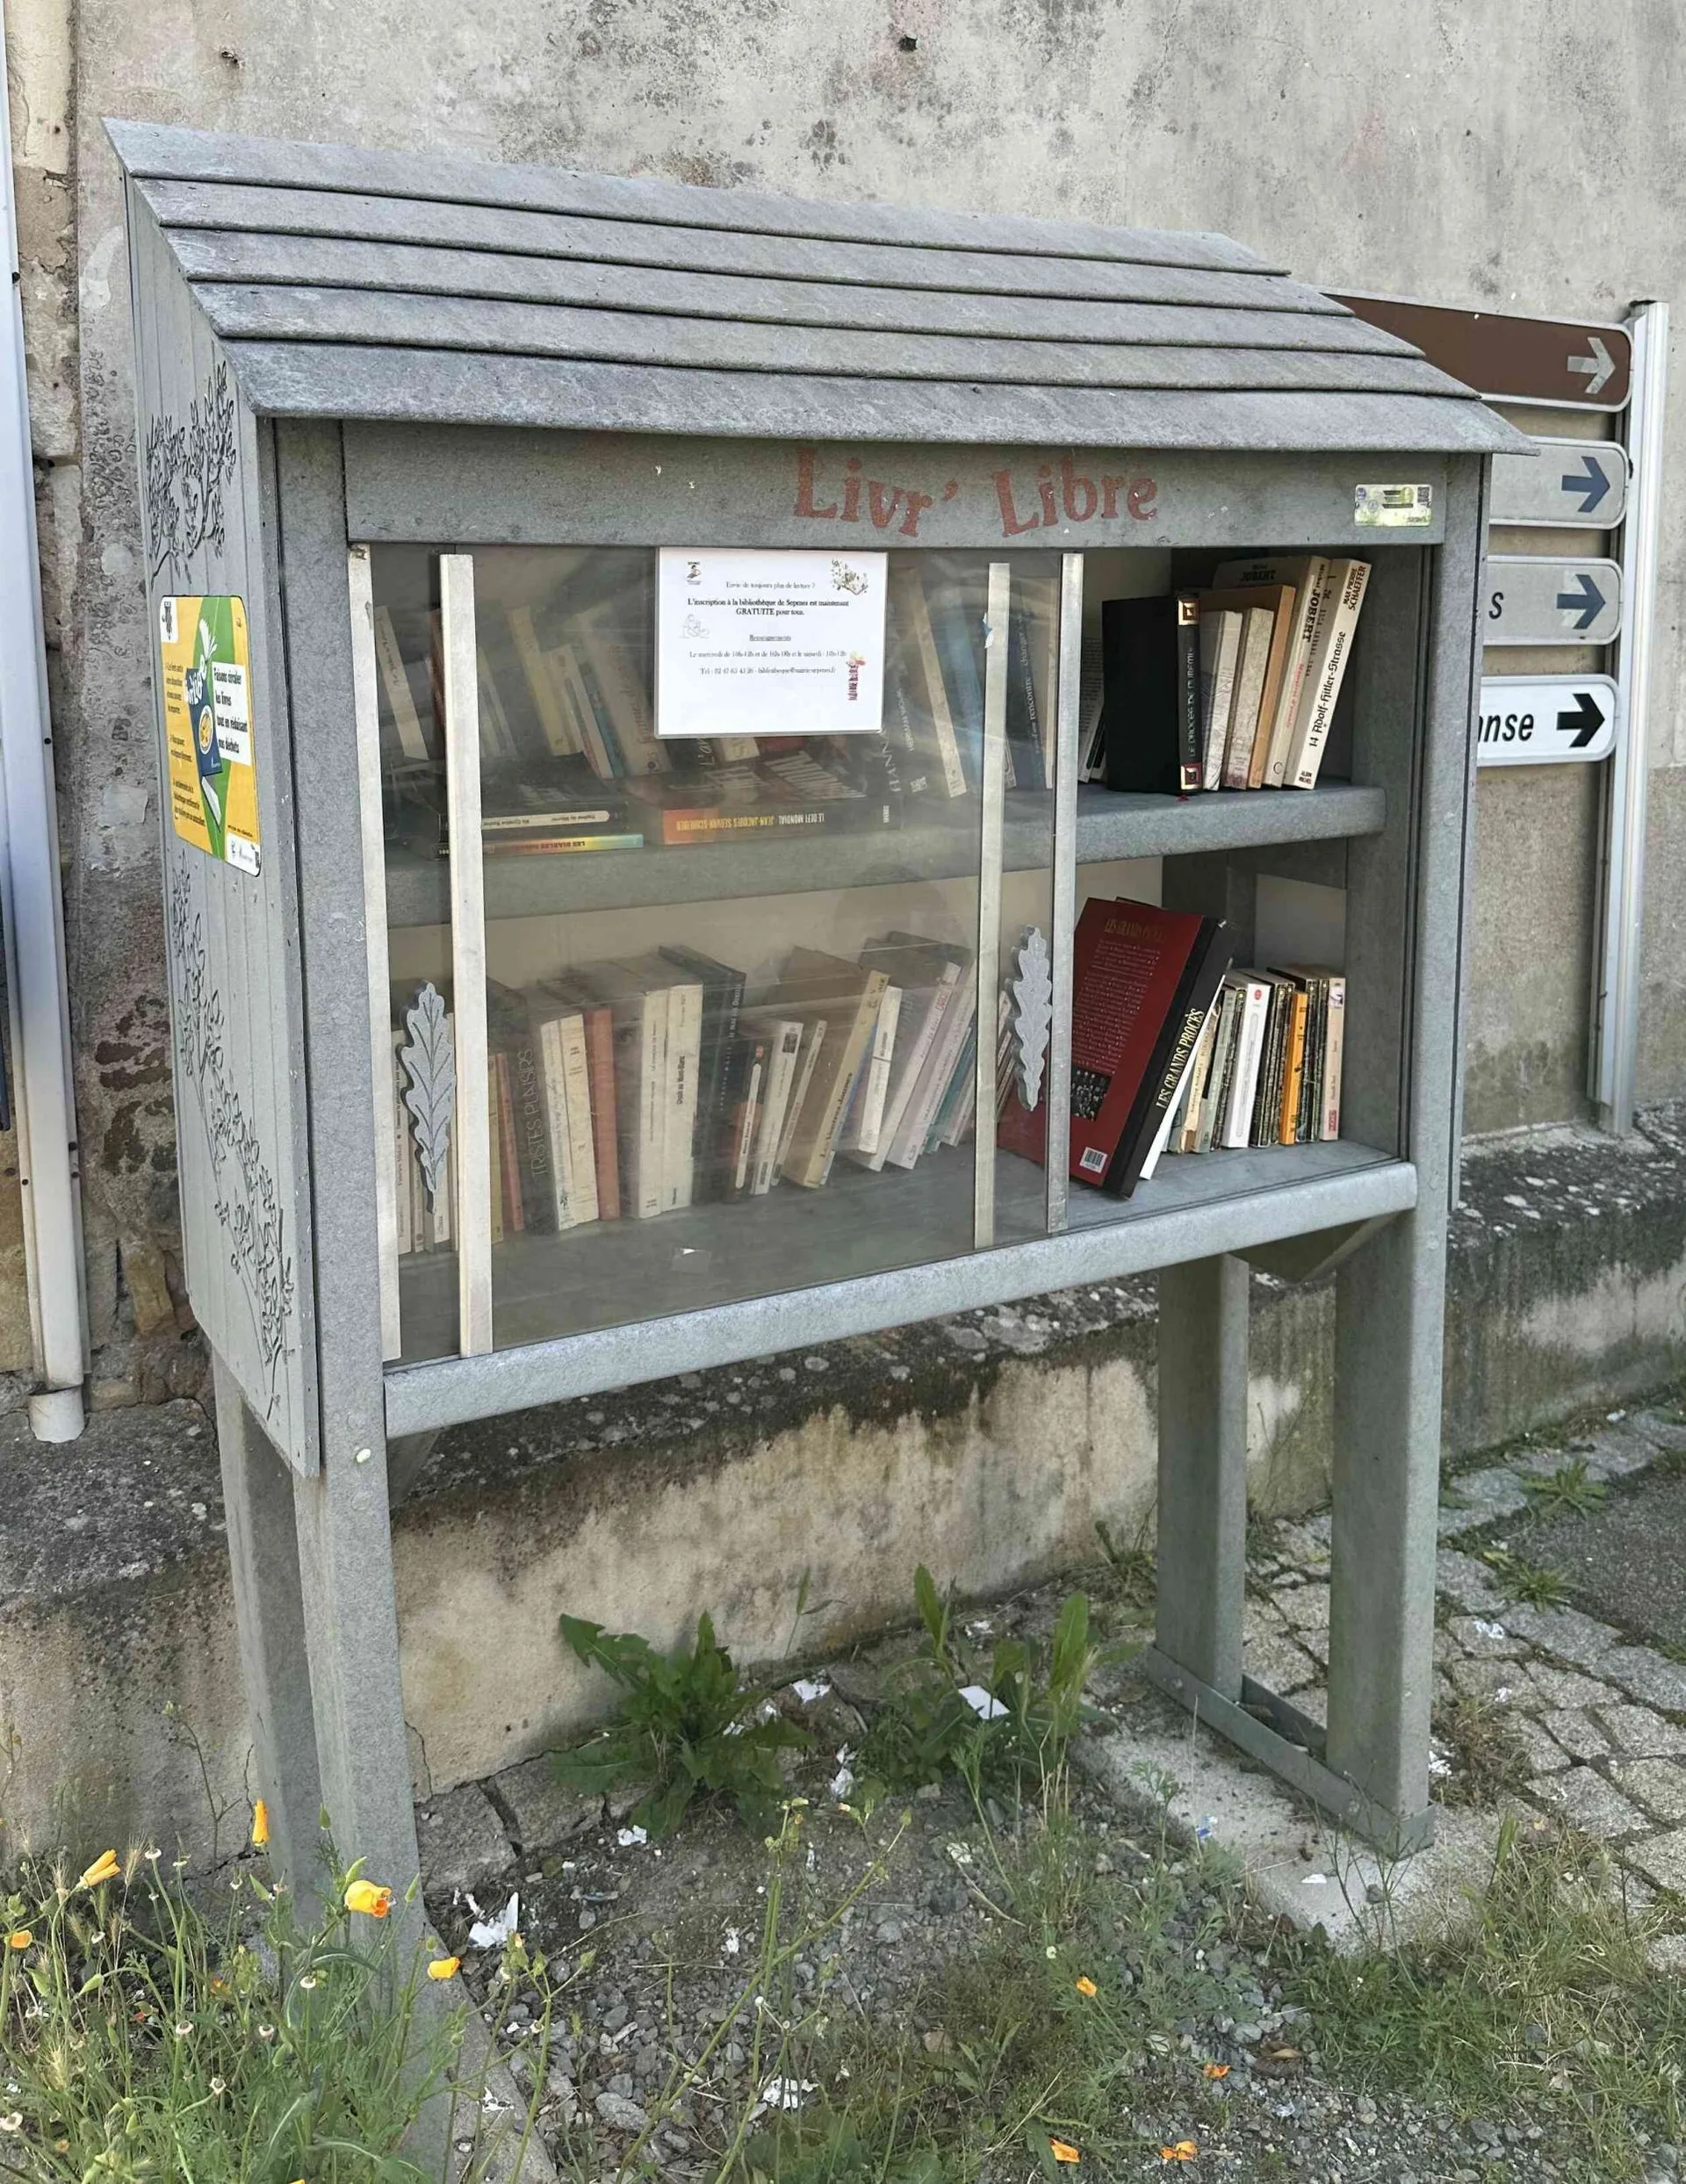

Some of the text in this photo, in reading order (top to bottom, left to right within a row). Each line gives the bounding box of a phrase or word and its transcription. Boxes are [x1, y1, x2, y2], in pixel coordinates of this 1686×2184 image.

[992, 454, 1158, 537] Libre
[1347, 567, 1358, 591] PIERRE
[1349, 566, 1366, 611] SCHAEFFER
[688, 598, 725, 607] L'inscription
[739, 598, 776, 608] bibliothèque
[1303, 588, 1322, 643] JOBERT
[1025, 676, 1037, 721] rencontre
[1308, 736, 1320, 748] 14
[1479, 714, 1534, 742] nse
[778, 814, 804, 825] MONDIAL
[1156, 1089, 1171, 1108] LES
[1164, 1047, 1190, 1090] GRANDS
[1178, 1008, 1205, 1050] PROCÈS
[518, 1049, 548, 1178] TRISTES PLAISIRS
